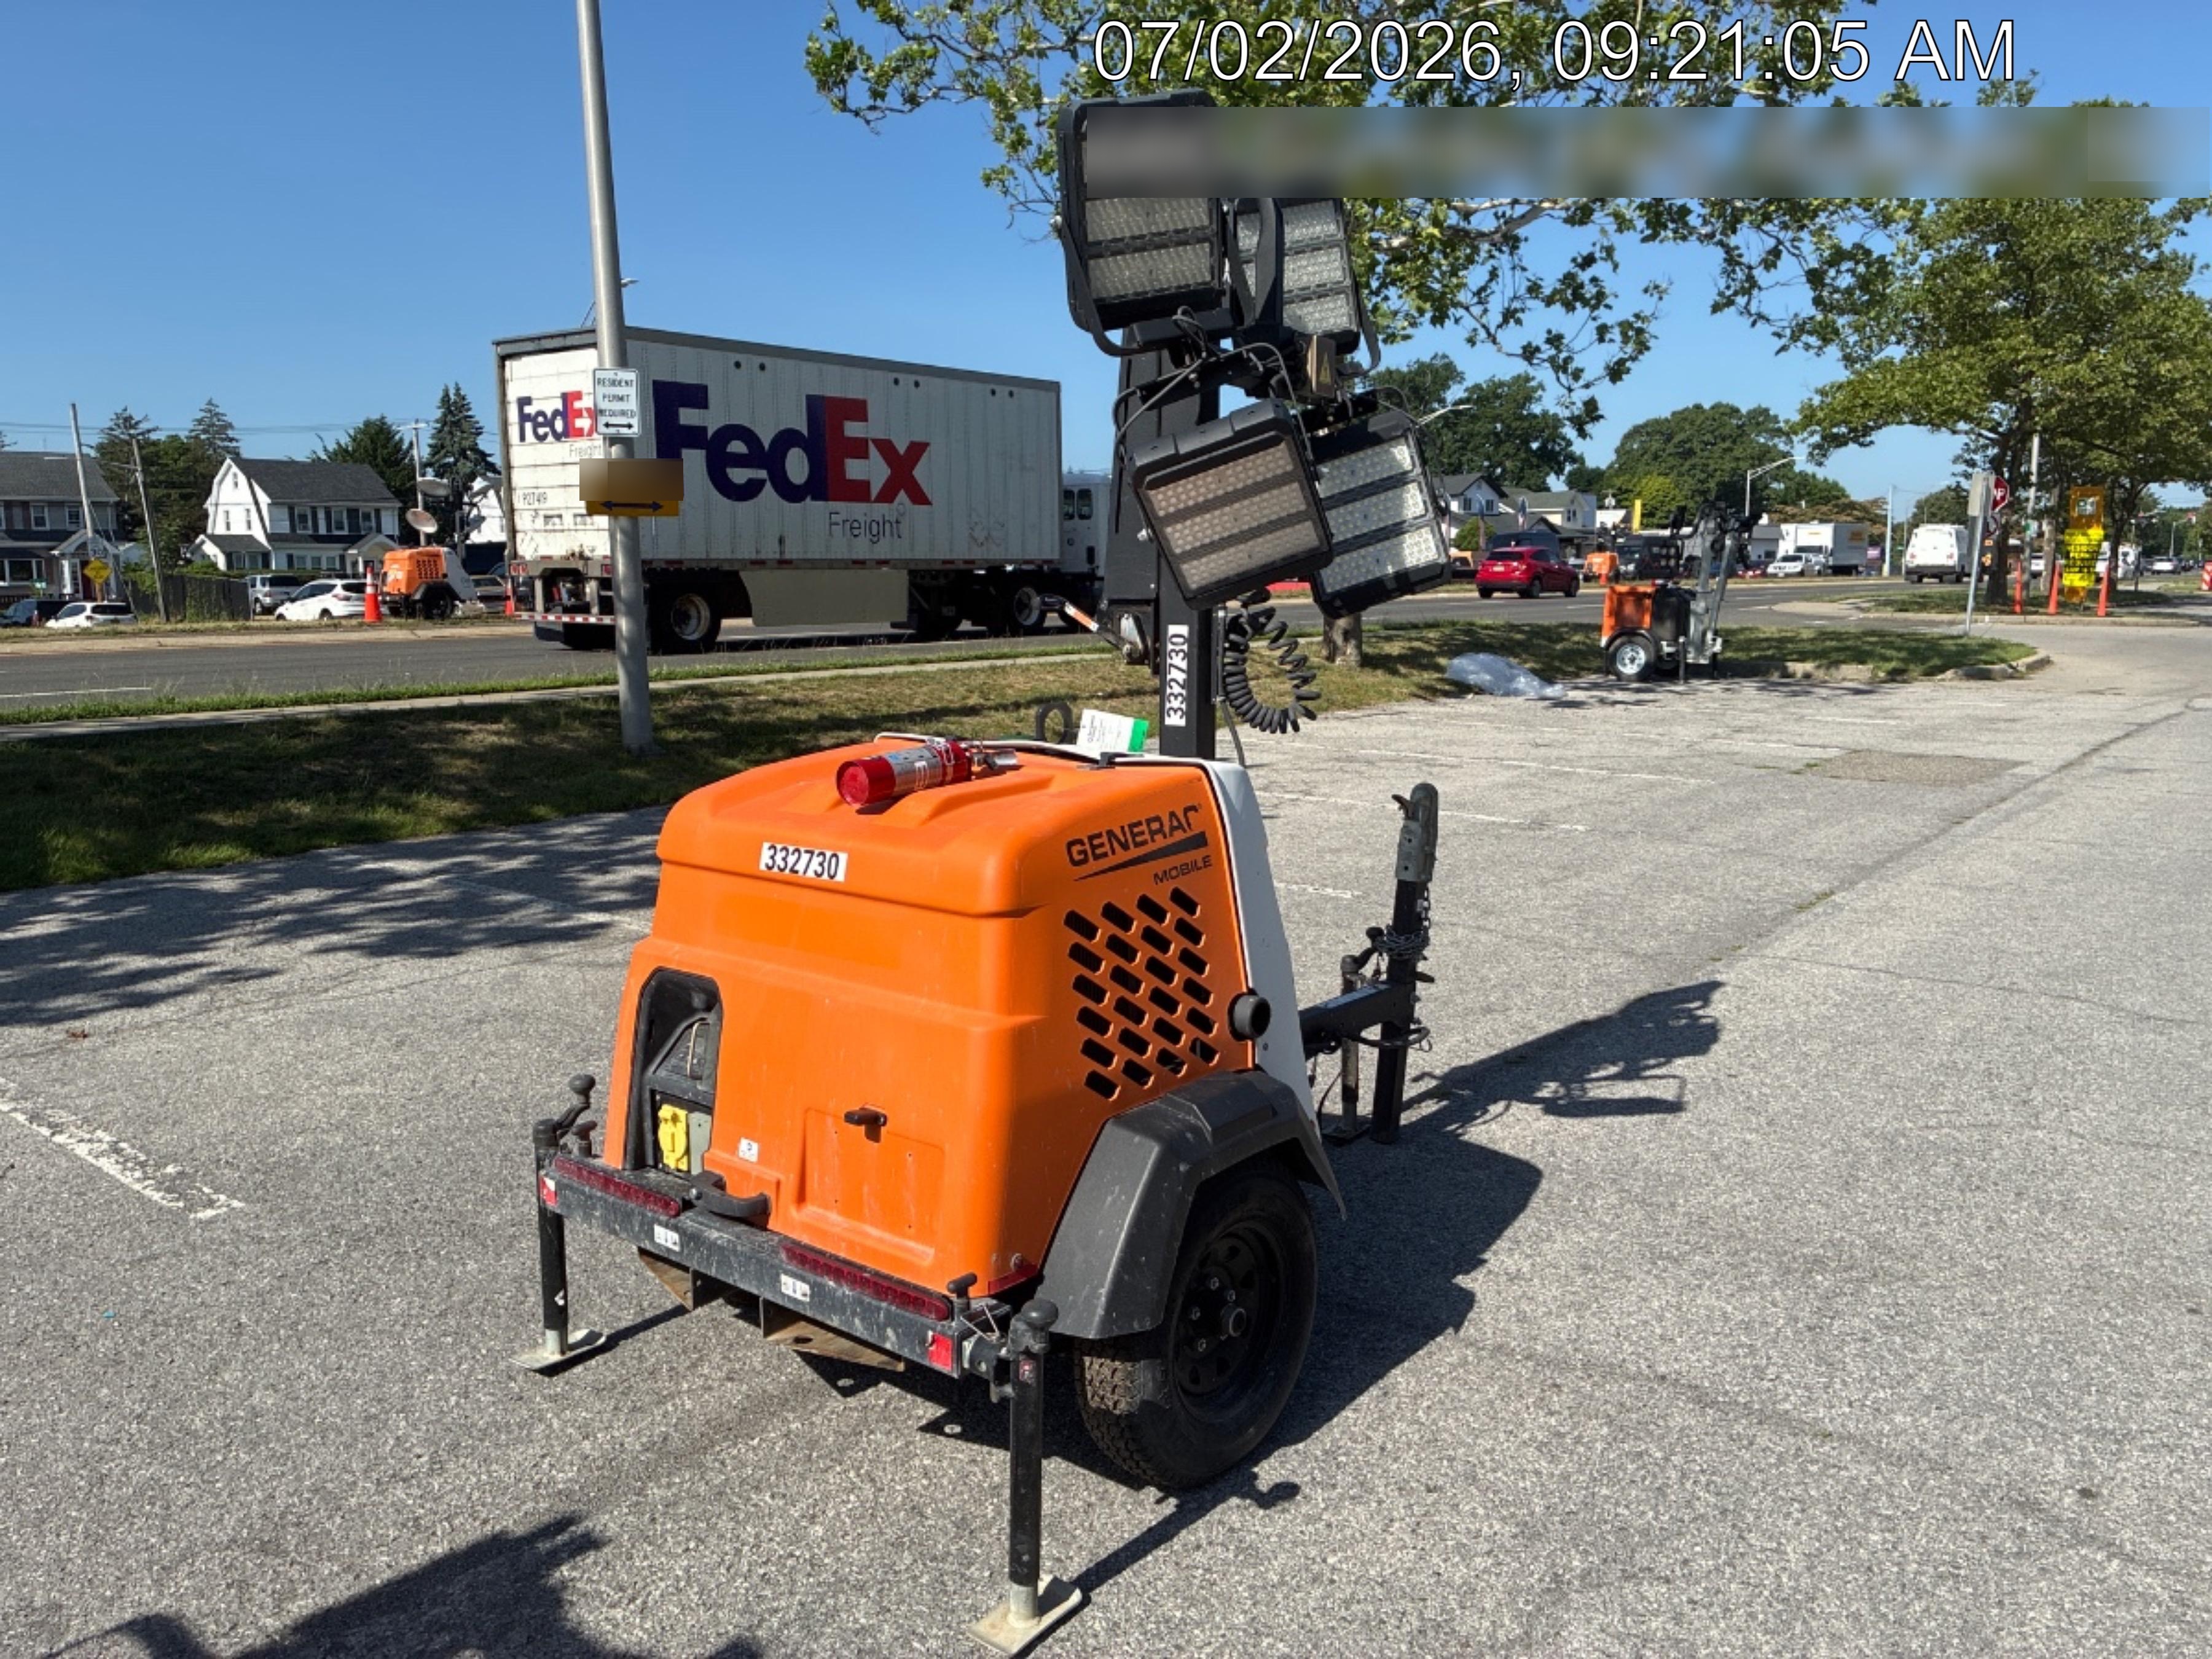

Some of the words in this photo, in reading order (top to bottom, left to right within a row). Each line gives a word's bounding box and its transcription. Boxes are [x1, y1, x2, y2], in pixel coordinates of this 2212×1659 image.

[597, 377, 634, 388] RESIDENT
[603, 393, 630, 402] PERMIT
[598, 409, 637, 418] REQUIRED
[652, 379, 933, 506] FedEx
[830, 511, 902, 544] Freight
[1166, 633, 1187, 720] 332730
[1066, 804, 1200, 867] GENERAC
[764, 843, 840, 880] 332730
[1153, 855, 1212, 885] MOBILE
